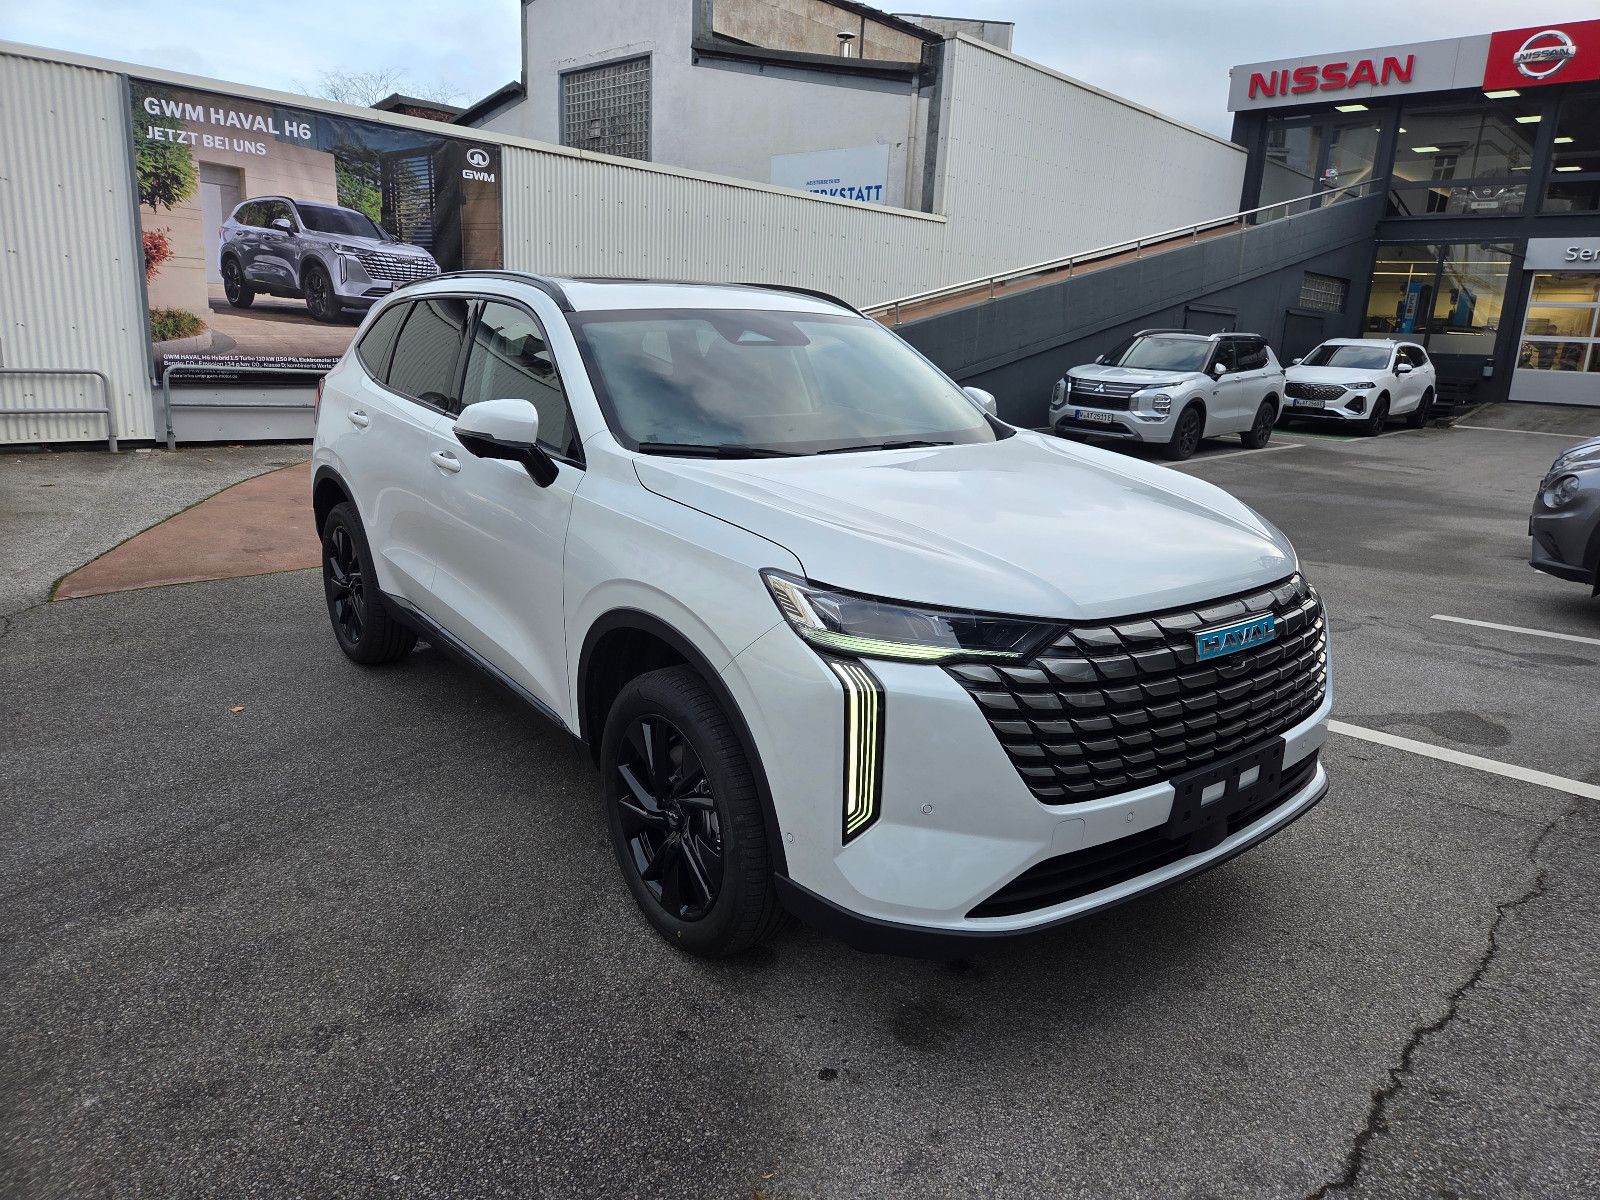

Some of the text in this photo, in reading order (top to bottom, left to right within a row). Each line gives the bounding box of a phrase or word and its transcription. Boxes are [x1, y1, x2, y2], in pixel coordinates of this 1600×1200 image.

[1519, 48, 1569, 61] NISSAN
[1248, 54, 1415, 99] NISSAN
[143, 97, 312, 140] GWM HAVAL H6
[146, 125, 267, 156] JETZT BEI UNS
[462, 169, 495, 183] GWM
[1202, 621, 1275, 654] HAVAL
